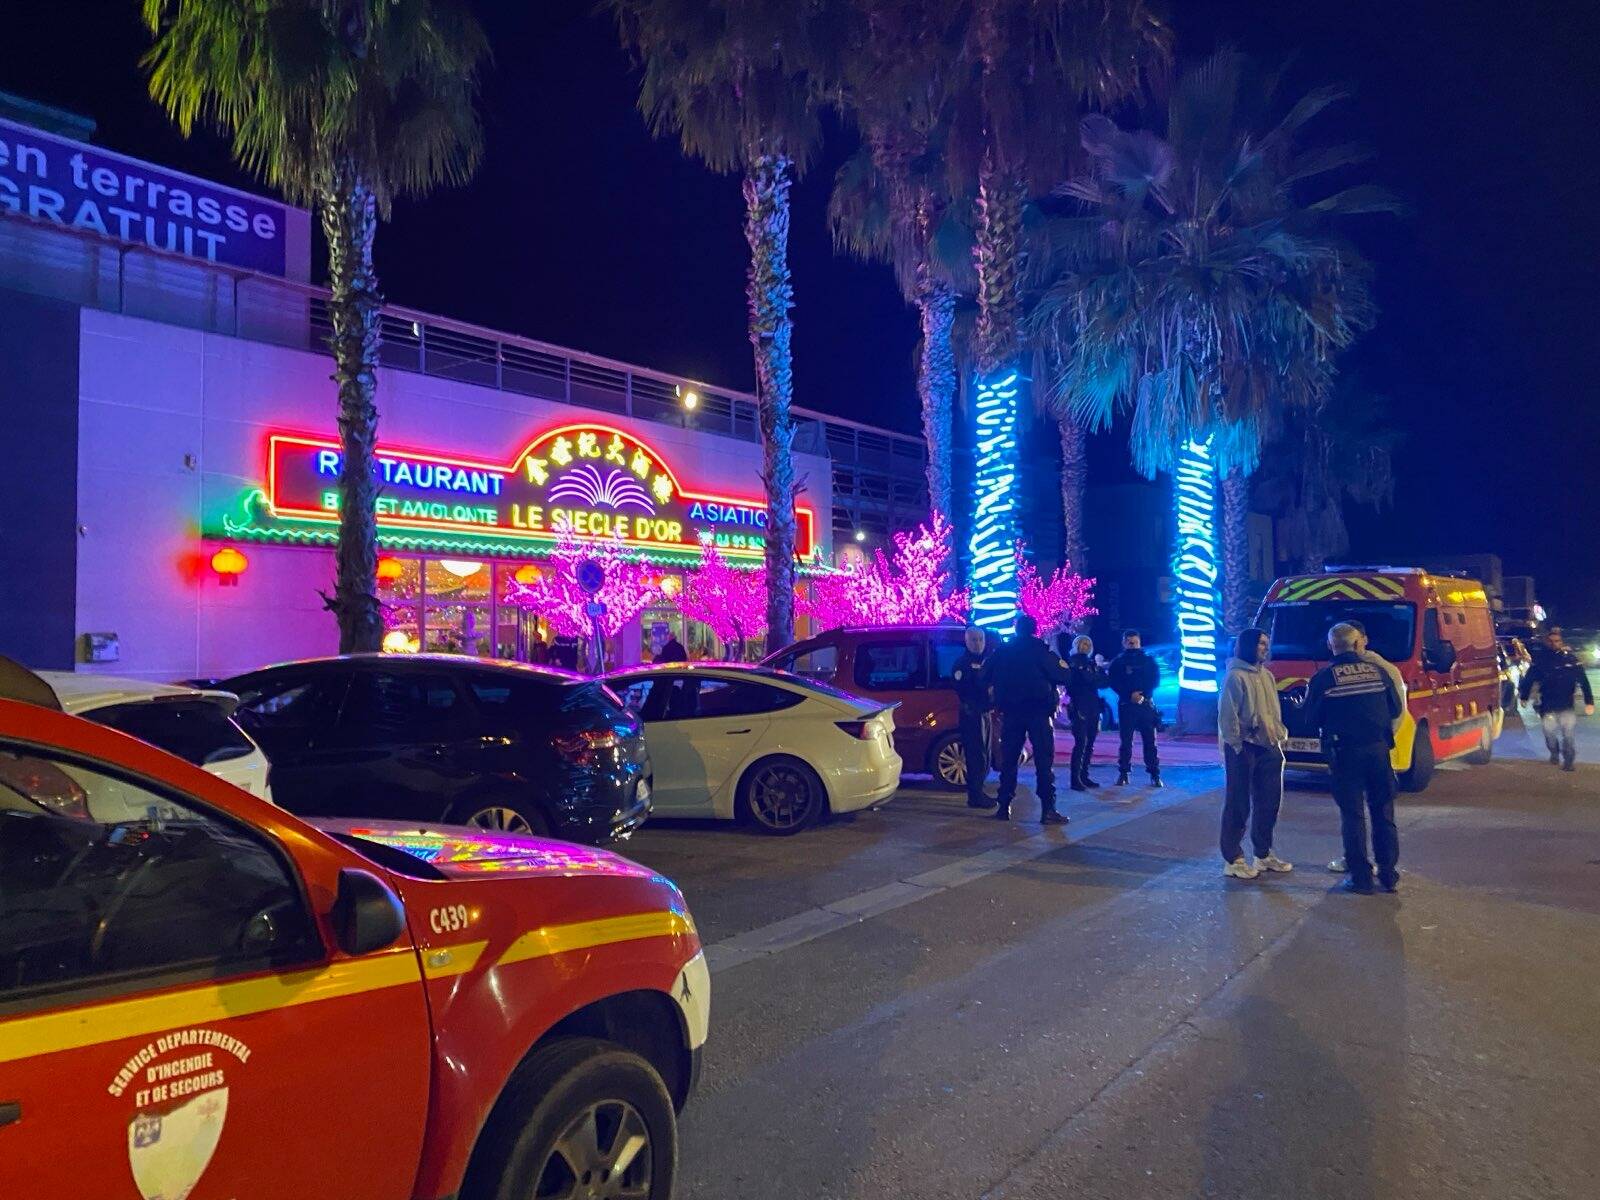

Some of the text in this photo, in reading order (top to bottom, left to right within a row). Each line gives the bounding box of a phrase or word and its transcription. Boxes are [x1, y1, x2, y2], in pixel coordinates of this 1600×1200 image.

[69, 152, 276, 240] terrasse
[319, 451, 505, 496] RTAURANT
[512, 503, 544, 530] LE
[551, 508, 629, 539] SIECLE
[636, 517, 682, 543] D'OR
[1334, 661, 1378, 677] POLICE
[430, 904, 468, 934] C439
[107, 1028, 252, 1098] SERVICE DEPARTEMENTAL
[147, 1052, 214, 1083] D'INCENDIE
[136, 1069, 224, 1108] ET DE SECOURS
